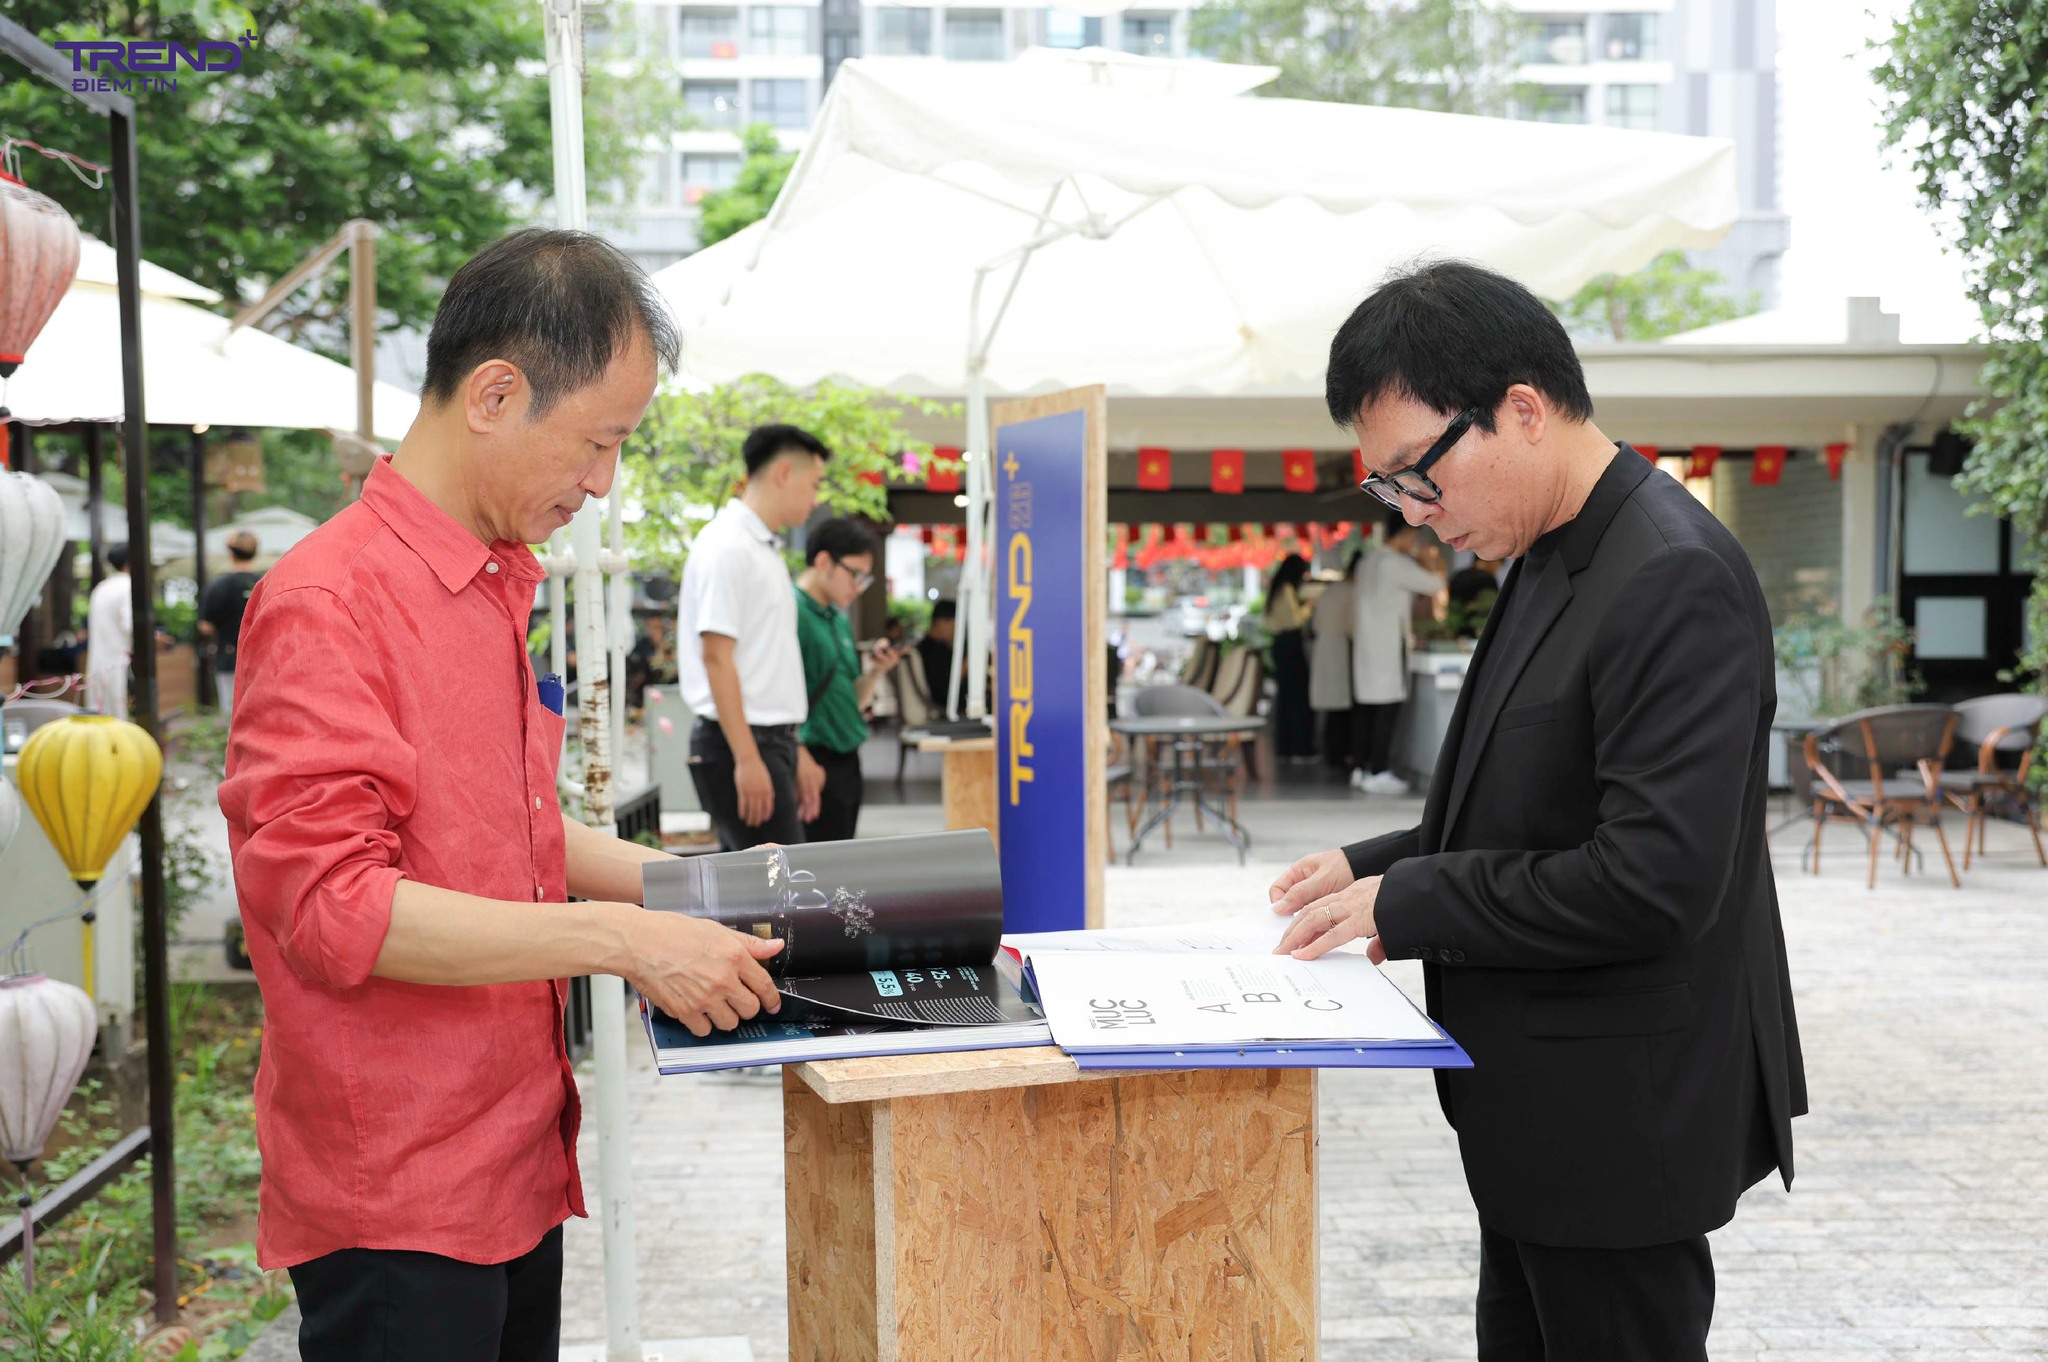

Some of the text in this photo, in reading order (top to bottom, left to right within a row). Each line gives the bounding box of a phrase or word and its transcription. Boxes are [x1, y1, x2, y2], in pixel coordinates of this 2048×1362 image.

[1009, 531, 1034, 806] TREND
[1242, 993, 1281, 1002] B
[1197, 1003, 1237, 1014] A
[1304, 1000, 1343, 1011] C
